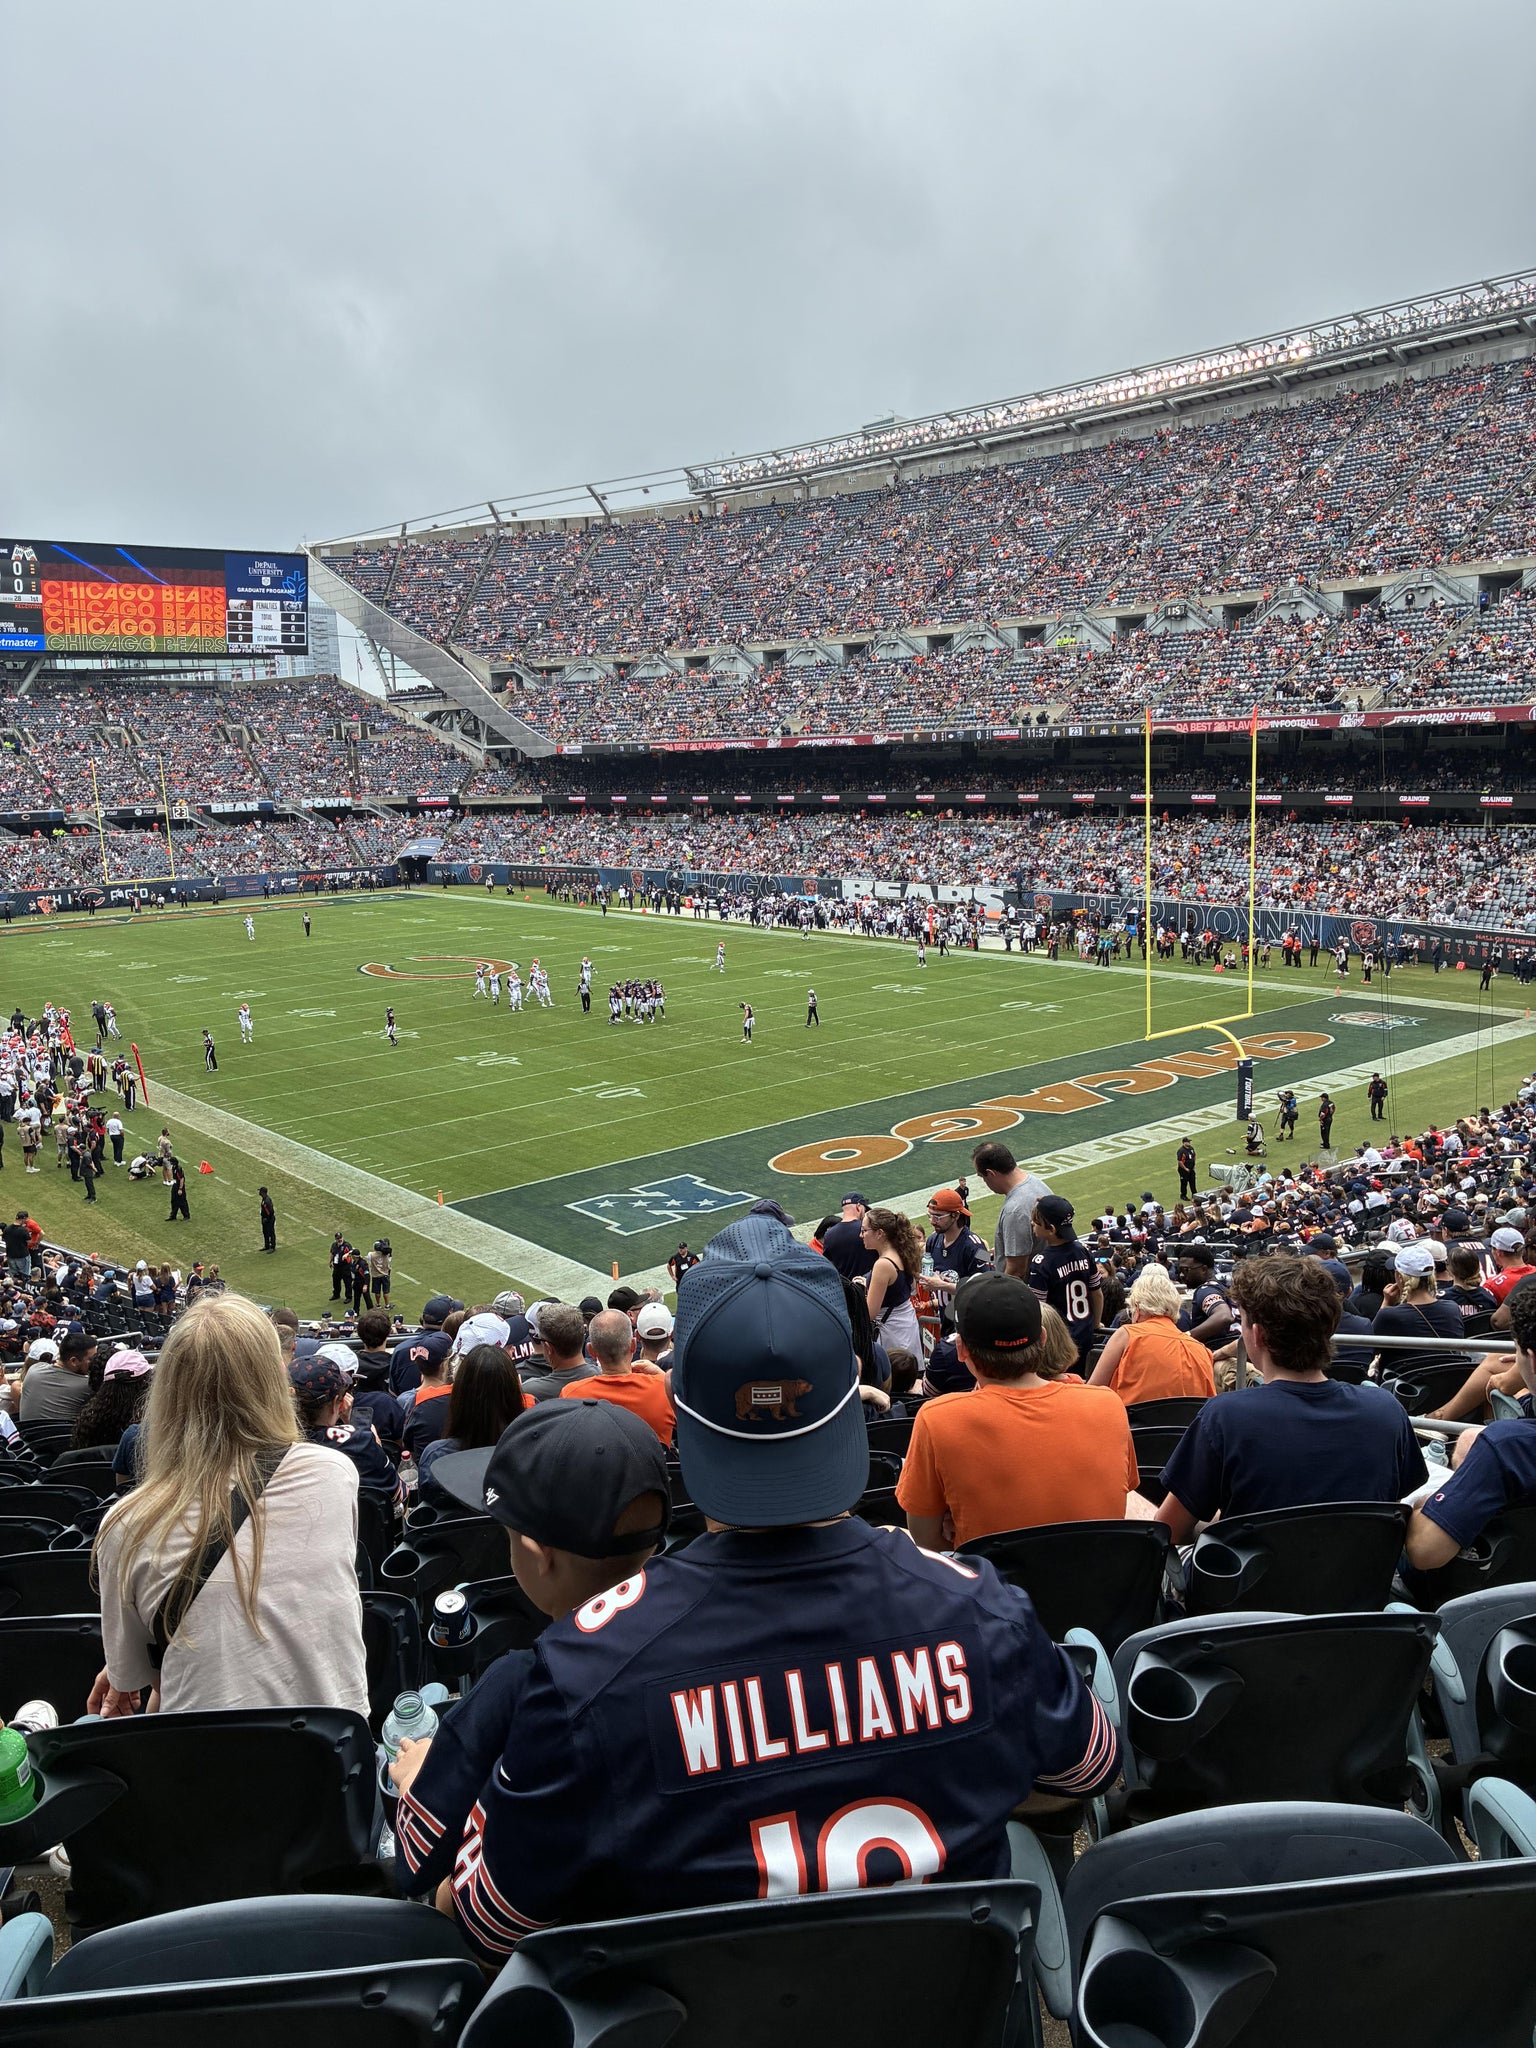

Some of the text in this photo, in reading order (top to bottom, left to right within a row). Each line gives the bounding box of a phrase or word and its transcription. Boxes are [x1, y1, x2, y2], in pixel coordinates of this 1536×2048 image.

[13, 561, 22, 576] 0
[248, 567, 284, 576] UNIVERSITY
[14, 579, 23, 593] 0
[43, 581, 226, 604] CHICAGO BEARS
[44, 599, 226, 621] CHICAGO BEARS
[256, 602, 278, 610] PENALTIES
[45, 616, 226, 638] CHICAGO BEARS
[46, 634, 226, 653] CHICAGO BEARS
[1190, 722, 1213, 731] BEST
[1280, 718, 1319, 728] FOOTBALL
[1417, 712, 1460, 725] pepper
[1460, 711, 1491, 721] THING
[931, 731, 982, 742] 0 0
[992, 729, 1019, 737] GRAINGER
[1026, 727, 1048, 738] 11:57
[1071, 727, 1080, 736] 23
[1089, 726, 1095, 735] 4
[1111, 725, 1117, 734] 4
[211, 802, 259, 813] BEAR
[301, 798, 351, 808] DOWN
[842, 879, 1005, 912] BEARS
[767, 1031, 1335, 1176] CHICAGO
[1146, 1111, 1230, 1136] ALL
[1099, 1135, 1151, 1155] OF
[1031, 1254, 1044, 1264] 18
[1057, 1259, 1089, 1278] WILLIAMS
[1066, 1280, 1089, 1321] 18
[670, 1640, 974, 1776] WILLIAMS
